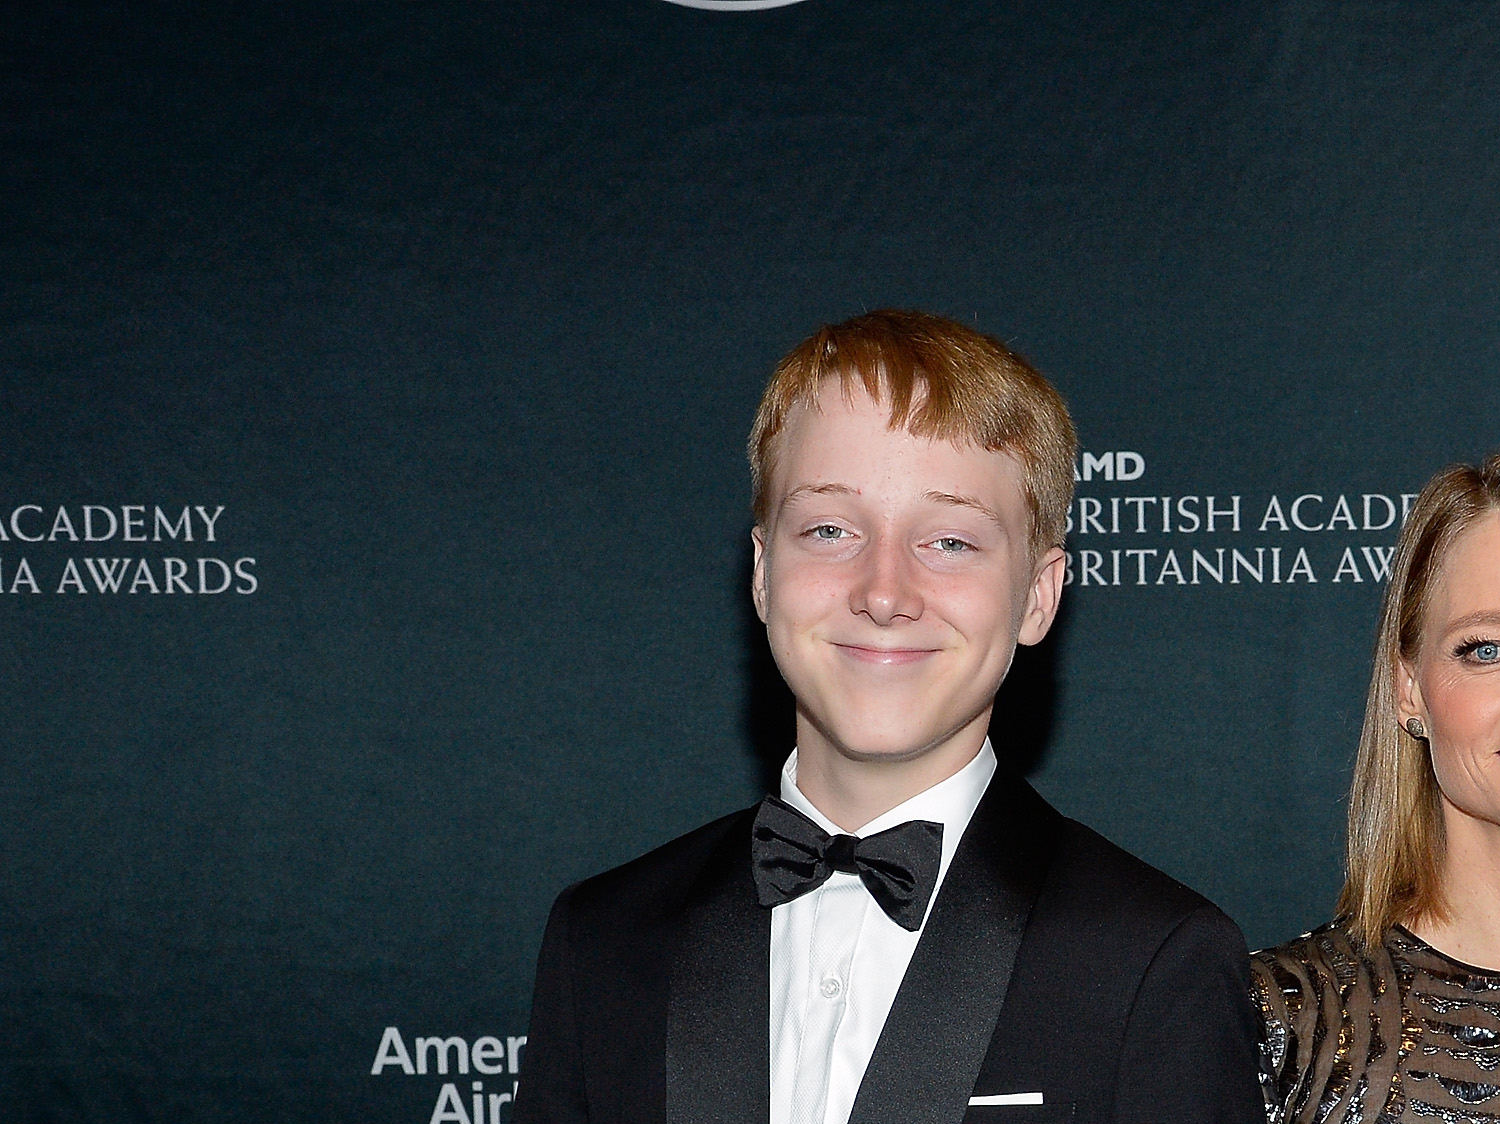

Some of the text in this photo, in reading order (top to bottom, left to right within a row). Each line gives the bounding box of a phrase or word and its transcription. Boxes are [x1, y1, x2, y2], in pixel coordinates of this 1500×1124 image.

[1072, 451, 1146, 482] MD
[56, 556, 258, 595] AWARDS
[370, 1026, 528, 1075] Amer
